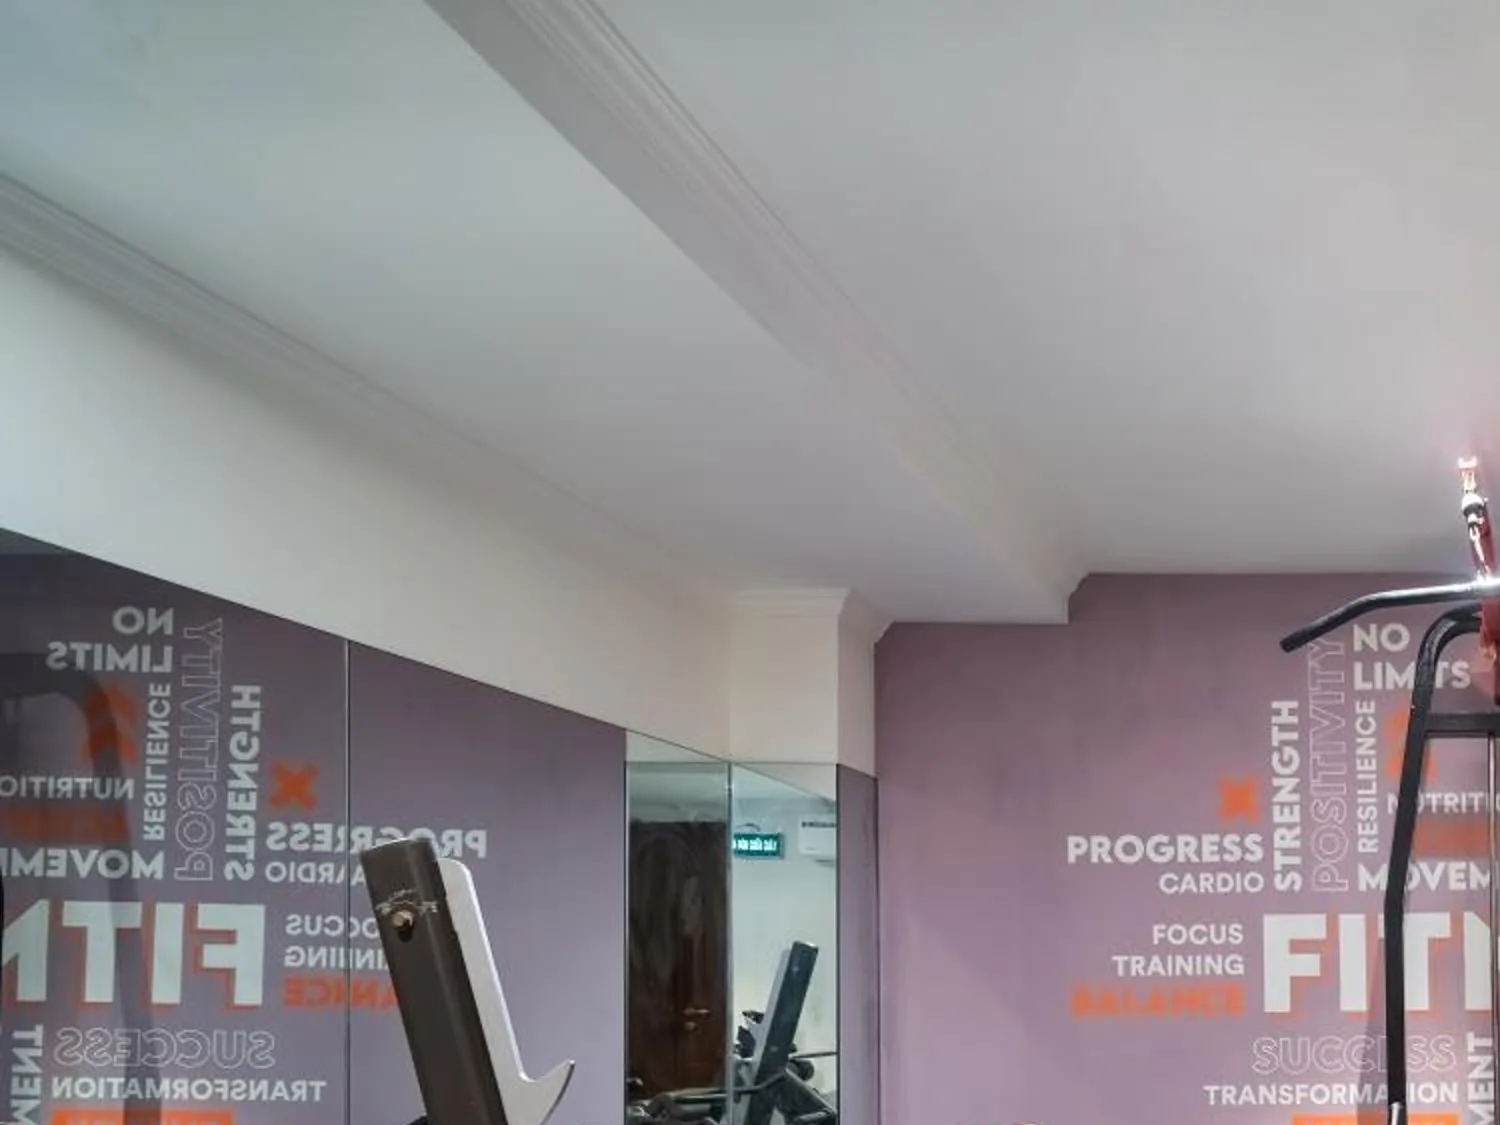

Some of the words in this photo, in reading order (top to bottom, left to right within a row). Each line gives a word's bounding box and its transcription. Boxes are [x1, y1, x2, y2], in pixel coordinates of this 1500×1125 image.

[1353, 624, 1410, 652] NO
[1353, 661, 1471, 690] LIMTS
[1307, 636, 1350, 893] POSITIVITY
[1356, 700, 1379, 853] RESILIENCE
[1271, 701, 1302, 892] STRENGTH
[1067, 834, 1264, 864] PROGRESS
[1159, 872, 1264, 894] CARDIO
[1152, 924, 1244, 946] FOCUS
[1112, 954, 1245, 977] TRAINING
[1204, 1081, 1458, 1106] TRANSFORMAION
